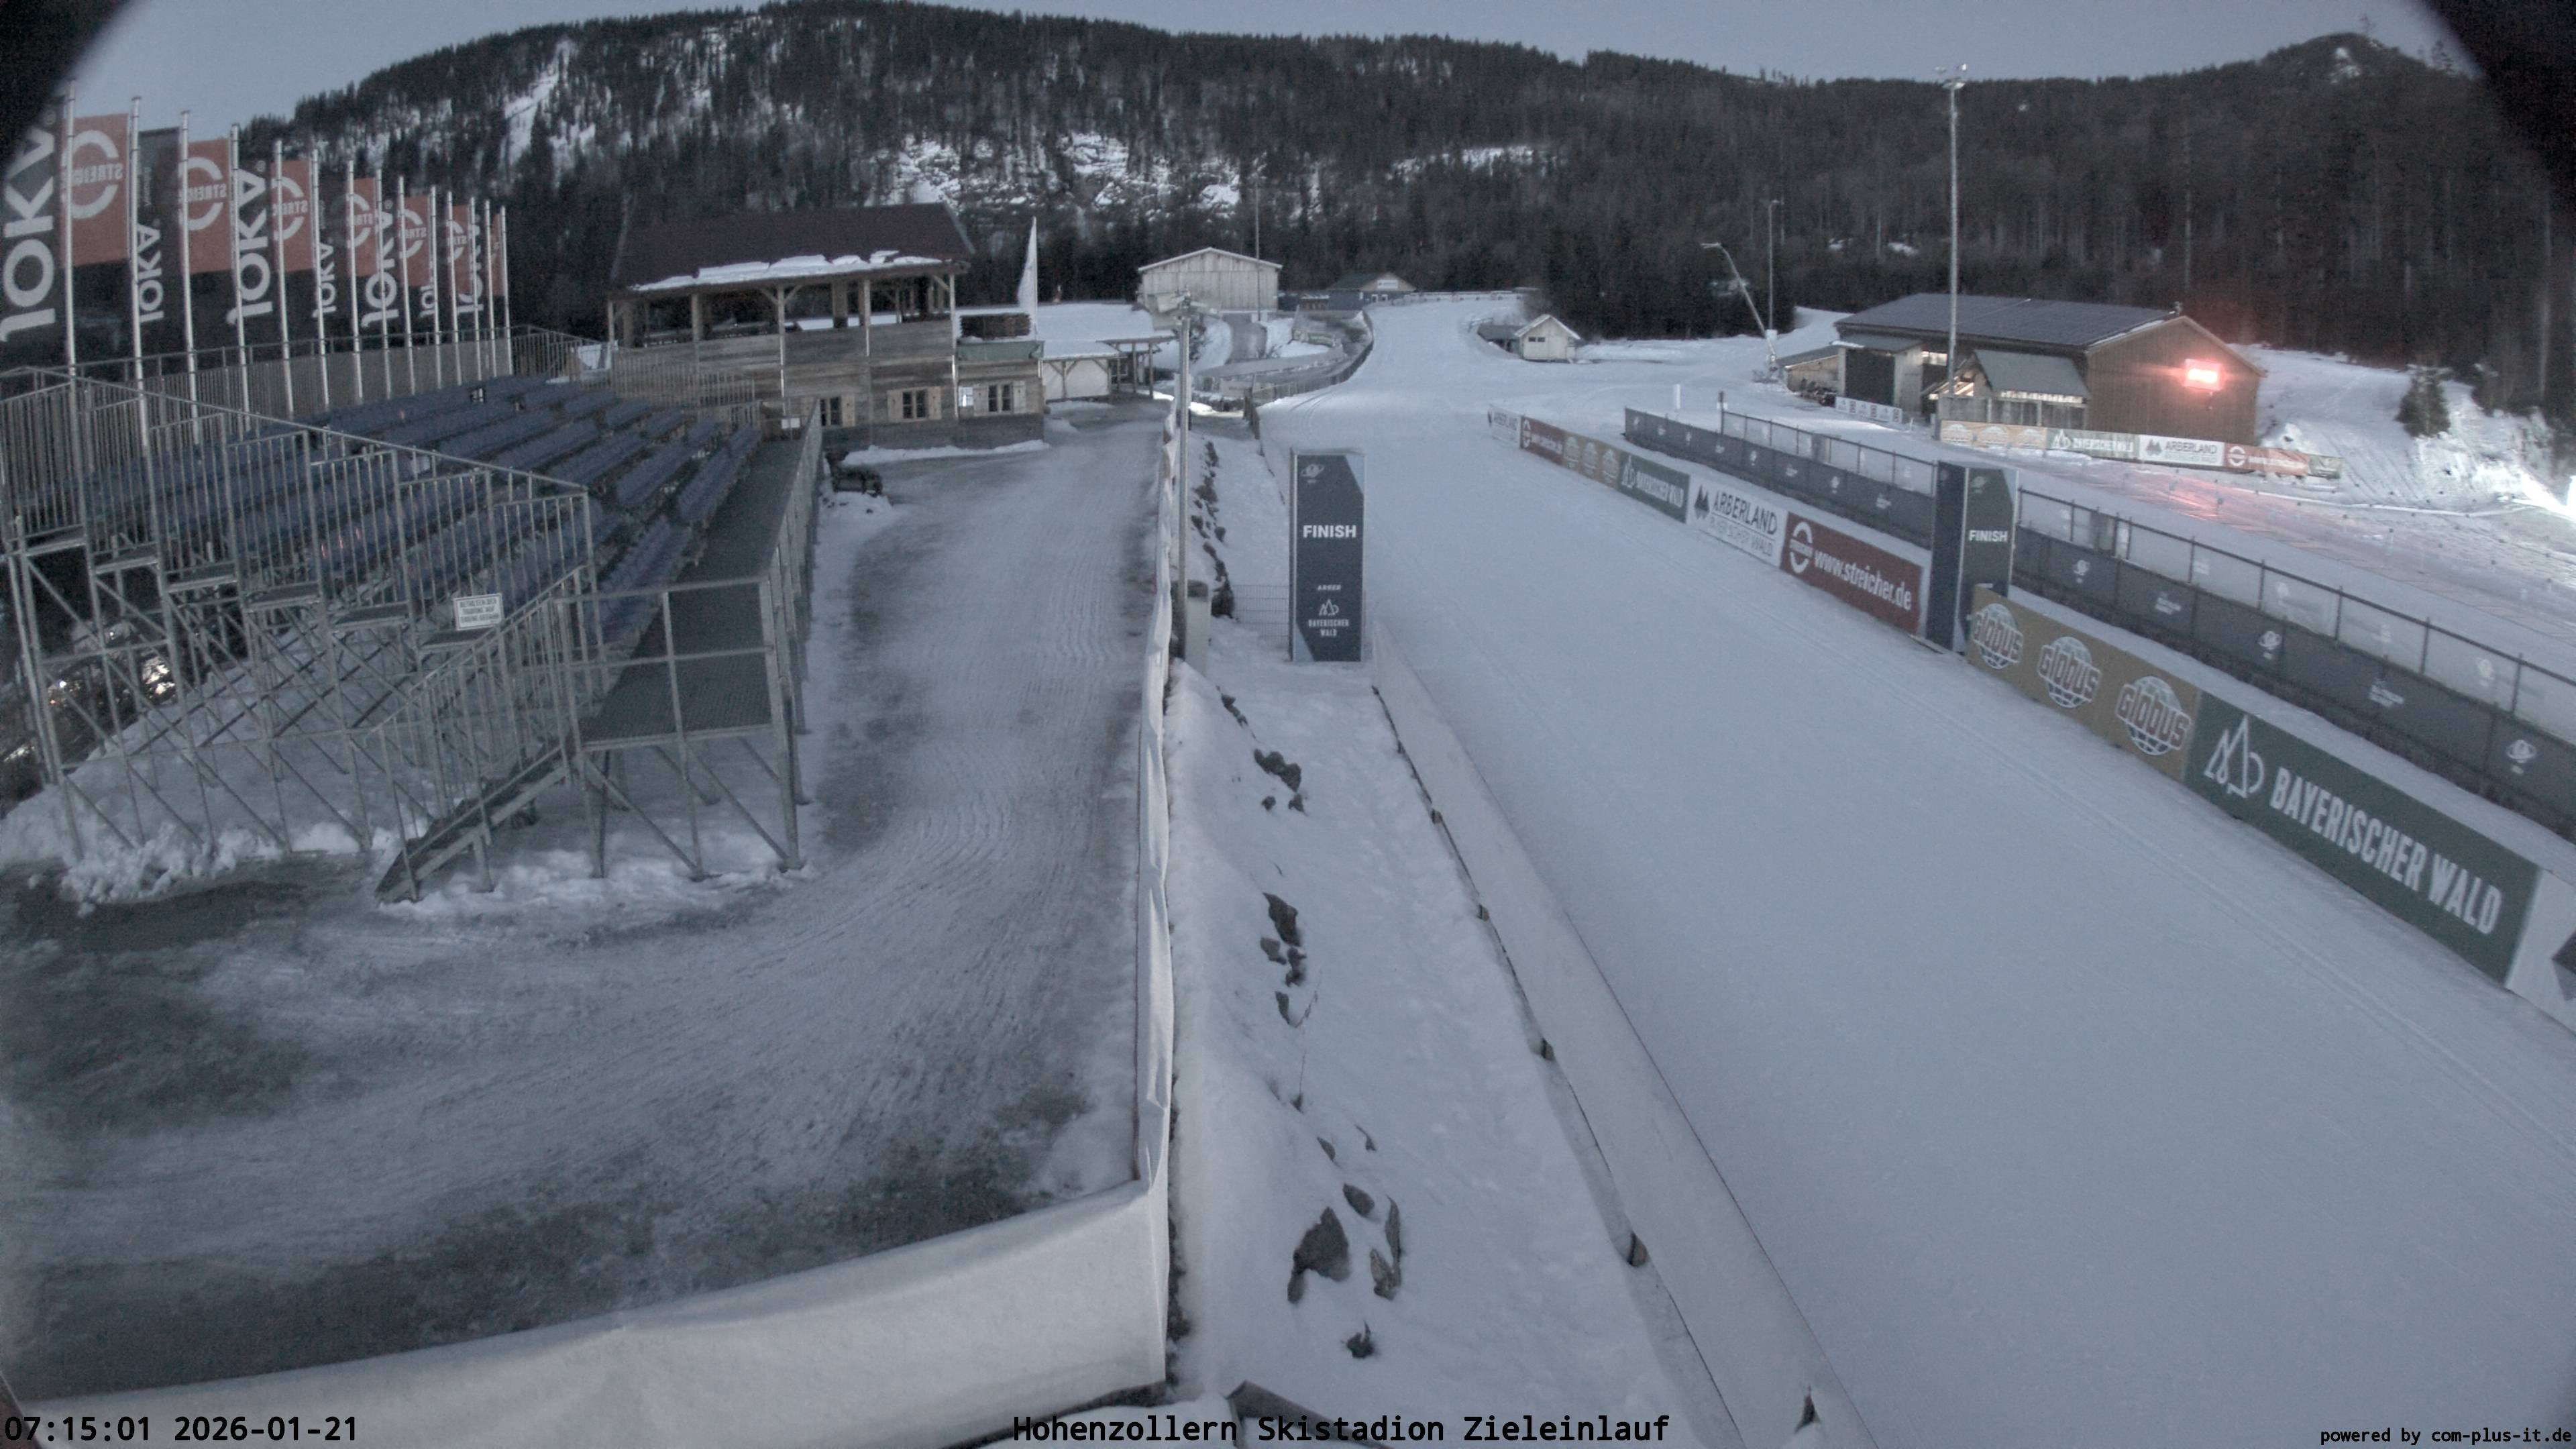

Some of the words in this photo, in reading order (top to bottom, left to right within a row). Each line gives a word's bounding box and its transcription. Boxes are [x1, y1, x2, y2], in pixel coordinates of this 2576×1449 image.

[2165, 441, 2217, 454] ARBERLAND
[1713, 490, 1778, 535] ARBERLAND
[1303, 525, 1356, 538] FINISH
[1968, 530, 2008, 542] FINISH
[1814, 549, 1912, 611] www.streicher.de
[2269, 767, 2427, 892] BAYERISCHER
[2428, 853, 2502, 934] WALD
